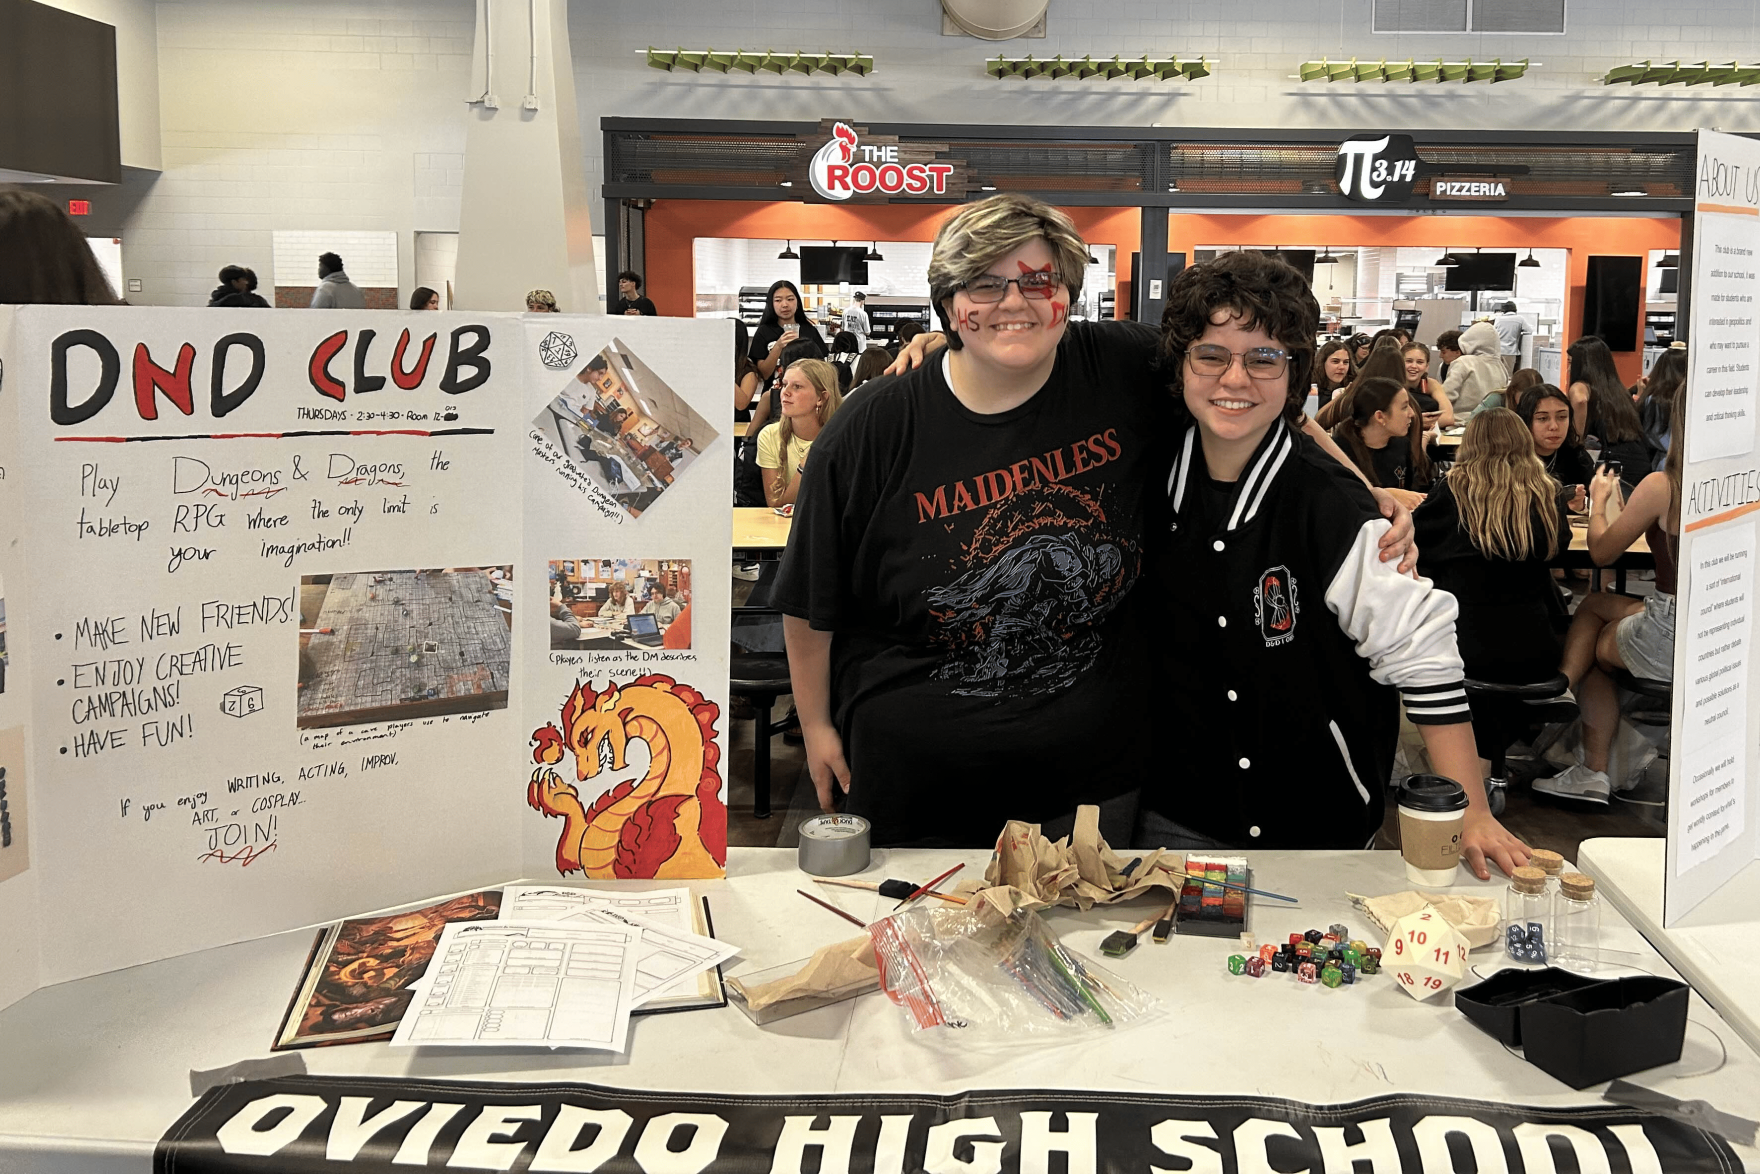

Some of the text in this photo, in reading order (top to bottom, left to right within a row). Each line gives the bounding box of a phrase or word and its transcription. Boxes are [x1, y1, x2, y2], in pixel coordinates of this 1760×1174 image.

[861, 145, 898, 162] THE
[826, 163, 953, 194] ROOST
[1372, 159, 1416, 182] 3.14
[1699, 154, 1740, 199] ABOUT
[1436, 182, 1506, 196] PIZZERIA
[50, 324, 492, 425] DND CLUB
[297, 407, 347, 421] THURSDAYS
[406, 410, 428, 421] Room
[81, 450, 450, 504] Play Dungeons & Dragons, the
[913, 428, 1122, 523] MAIDENLESS
[577, 482, 587, 494] his
[78, 495, 439, 541] tabletop RPG where the only limit is
[168, 528, 352, 573] your imagination!!
[75, 586, 296, 651] MAKE NEW FRIENDS!
[72, 642, 243, 689] ENJOY CREATIVE
[588, 653, 611, 664] listen
[625, 651, 639, 662] the
[642, 651, 658, 661] DM
[660, 652, 697, 662] describes
[579, 668, 602, 678] their
[72, 680, 180, 725] CAMPAIGNS!
[74, 713, 193, 757] HAVE FUN!
[314, 733, 329, 742] map
[336, 728, 343, 736] of
[387, 721, 413, 732] players
[313, 742, 332, 750] their
[120, 752, 399, 821] If you enjoy WRITING, ACTING, IMPROV,
[191, 808, 219, 827] ART,
[230, 809, 241, 817] or
[205, 814, 278, 852] JOIN!
[1420, 913, 1432, 921] 2
[1395, 938, 1403, 956] 9
[1408, 930, 1427, 945] 10
[1434, 947, 1450, 965] 11
[1457, 943, 1466, 962] 12
[1397, 972, 1414, 985] 18
[1424, 976, 1442, 990] 19
[216, 1094, 729, 1174] OVIEDO
[772, 1110, 1100, 1174] HIGH
